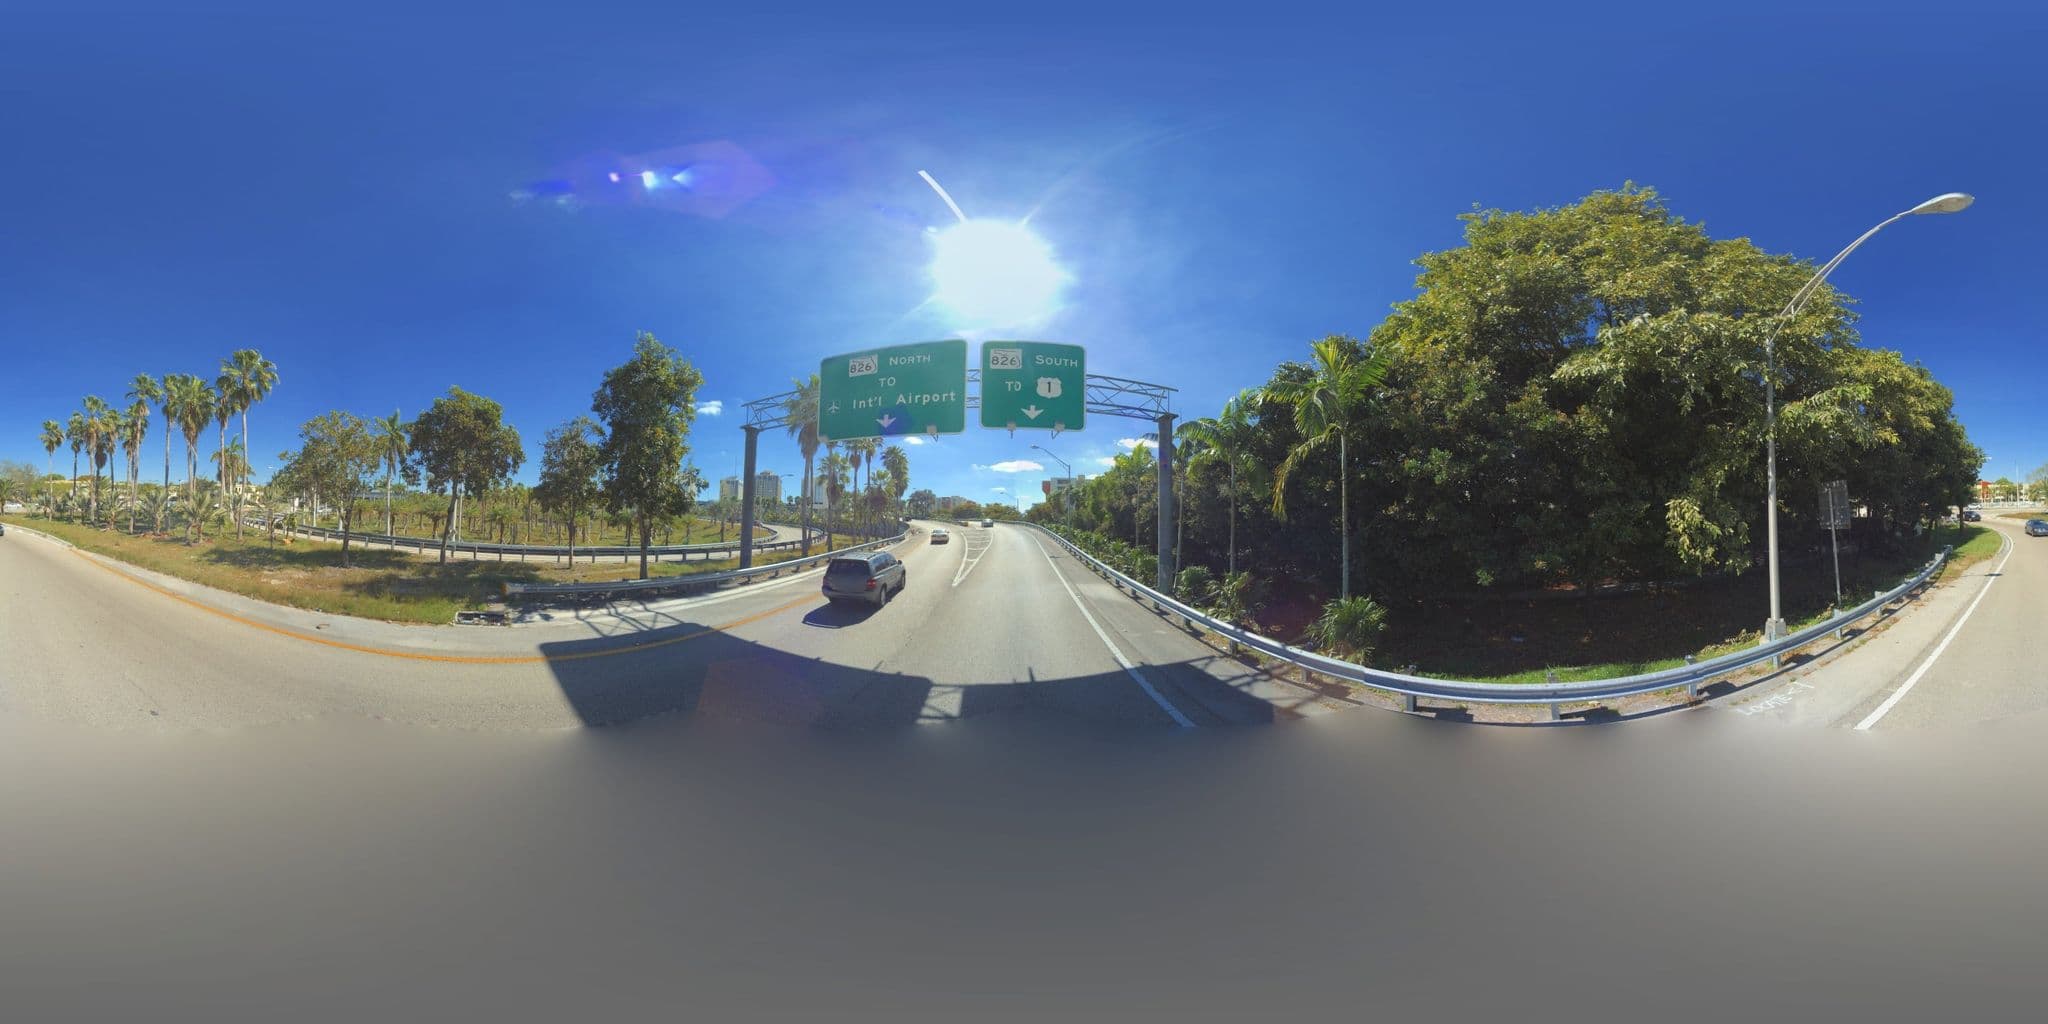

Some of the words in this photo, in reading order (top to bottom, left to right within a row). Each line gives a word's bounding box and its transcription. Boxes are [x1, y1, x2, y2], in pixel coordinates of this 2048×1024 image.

[850, 363, 872, 374] 826
[889, 354, 931, 366] NORTH
[991, 356, 1017, 366] 826
[1035, 354, 1078, 368] SOUTH
[878, 376, 896, 388] TO
[1005, 381, 1022, 392] TO
[852, 396, 882, 409] Int'l
[896, 391, 956, 405] Airport
